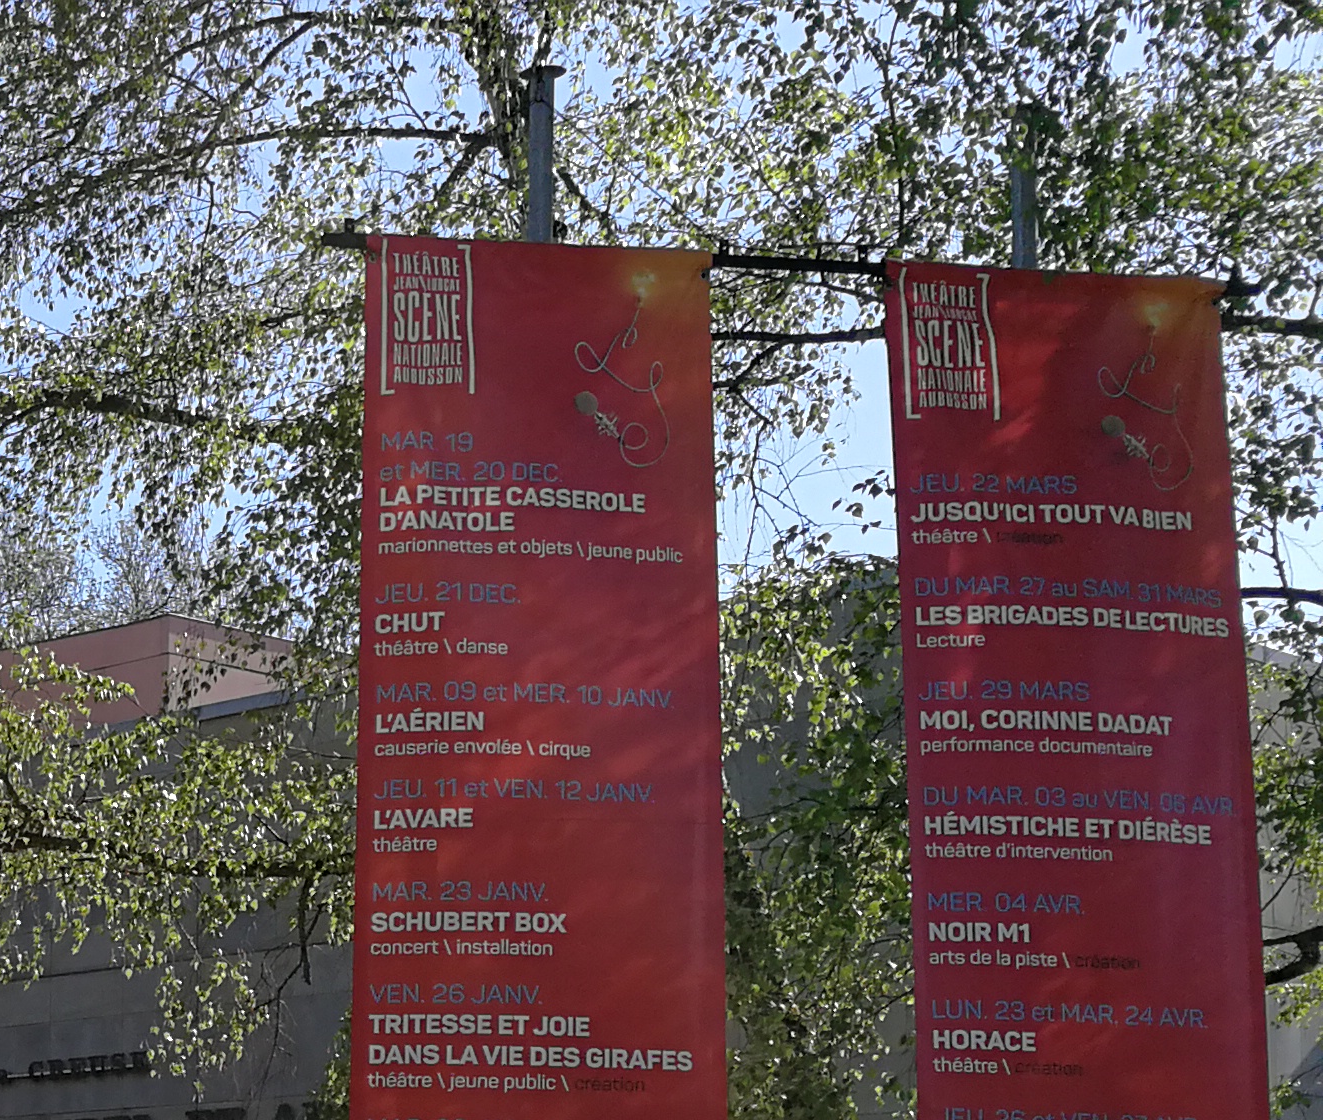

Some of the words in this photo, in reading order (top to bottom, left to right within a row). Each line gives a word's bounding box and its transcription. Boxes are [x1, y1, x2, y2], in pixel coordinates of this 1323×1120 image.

[393, 251, 459, 277] THÉÂTRE
[393, 343, 462, 367] NATIONALE
[394, 366, 463, 385] AUBUSSON
[380, 485, 411, 506] LA
[417, 486, 501, 506] PETITE
[506, 488, 646, 514] CASSEROLE
[380, 512, 515, 532] D'ANATOLE
[1039, 504, 1106, 525] TOUT
[1109, 506, 1139, 528] VA
[1143, 511, 1192, 531] BIEN
[379, 538, 493, 554] marionnettes
[497, 539, 516, 554] et
[521, 539, 573, 558] objets
[587, 542, 632, 561] jeune
[636, 545, 683, 563] public
[375, 611, 445, 634] CHUT
[916, 633, 985, 648] Lecture
[375, 708, 485, 734] L'AÉRIEN
[920, 710, 975, 732] MOI,
[981, 710, 1093, 732] CORINNE
[1098, 713, 1172, 736] DADAT
[374, 740, 449, 757] causerie
[454, 739, 522, 755] envolée
[539, 741, 591, 760] cirque
[920, 738, 1034, 755] performance
[1039, 738, 1153, 757] documentaire
[373, 808, 474, 830] L'AVARE
[371, 911, 510, 932] SCHUBERT
[515, 913, 567, 933] BOX
[370, 940, 439, 955] concert
[456, 940, 553, 956] installation
[933, 1030, 1036, 1052] HORACE
